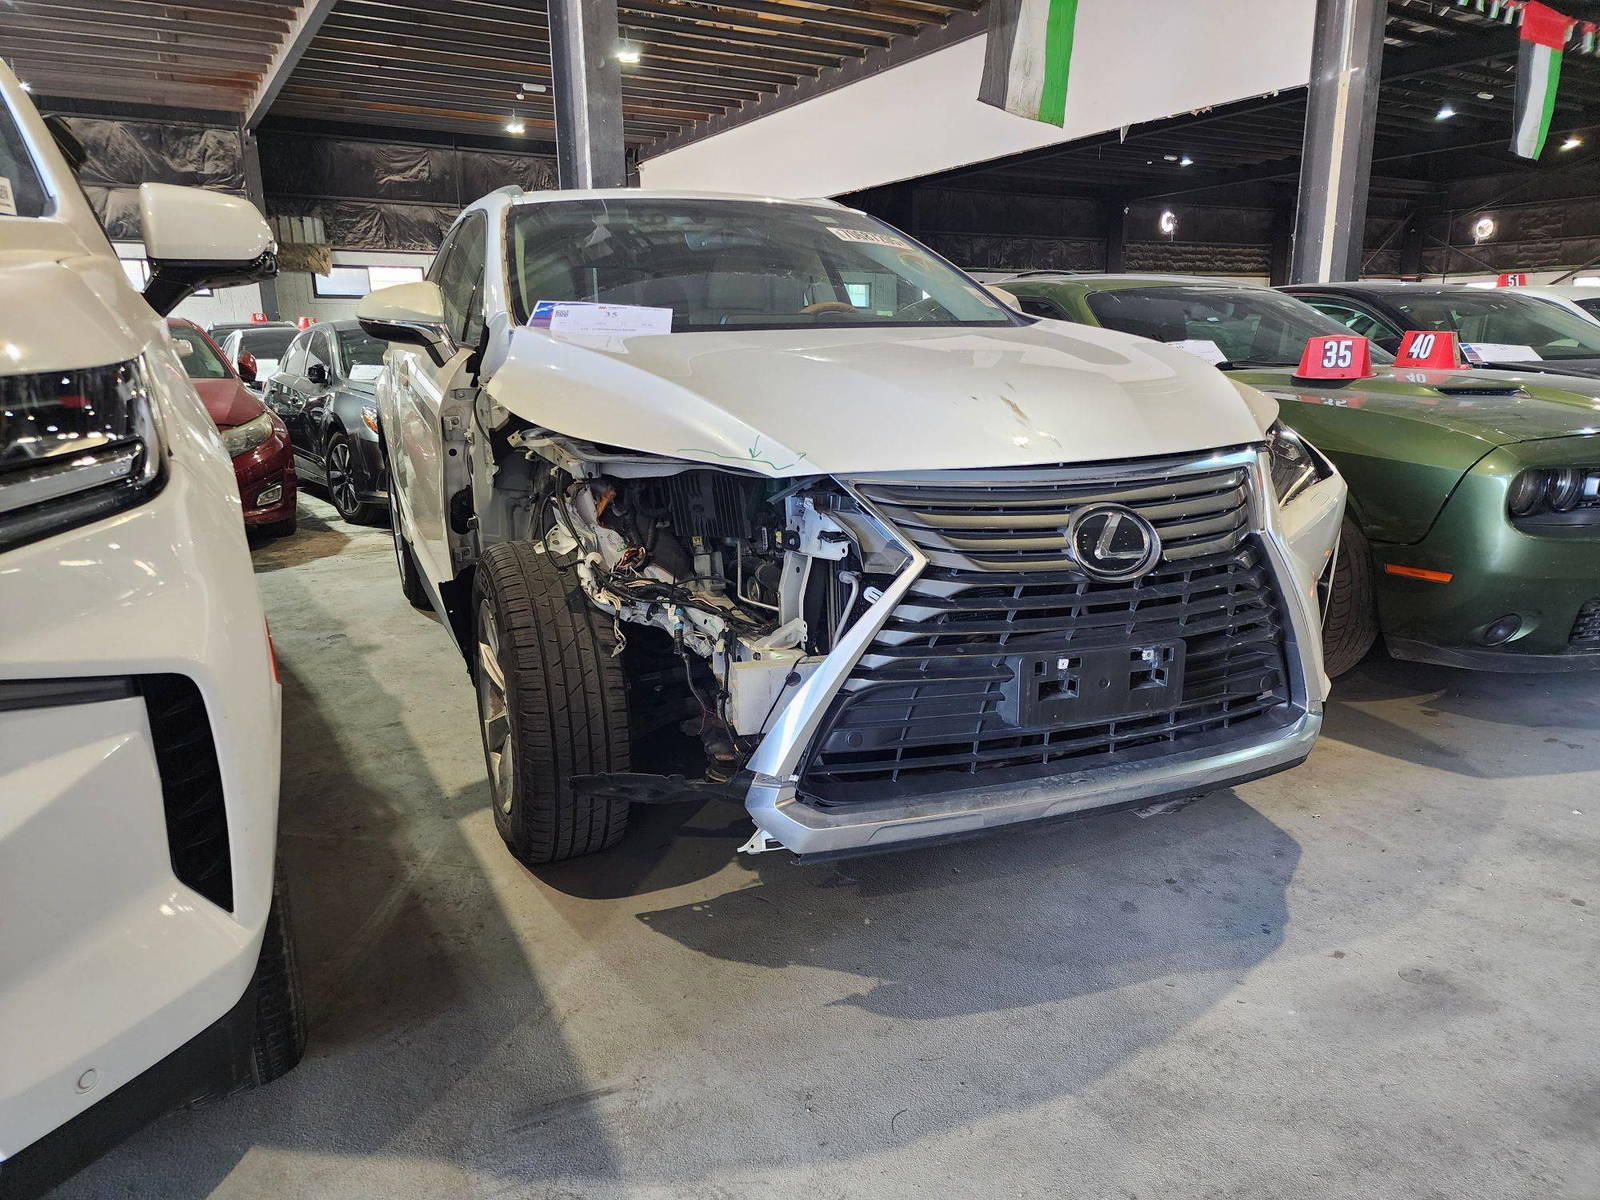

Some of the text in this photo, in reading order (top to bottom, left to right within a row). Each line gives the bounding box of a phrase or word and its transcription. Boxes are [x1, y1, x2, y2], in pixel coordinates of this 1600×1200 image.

[1508, 274, 1519, 287] 51
[1323, 340, 1352, 368] 35
[1409, 333, 1436, 359] 40
